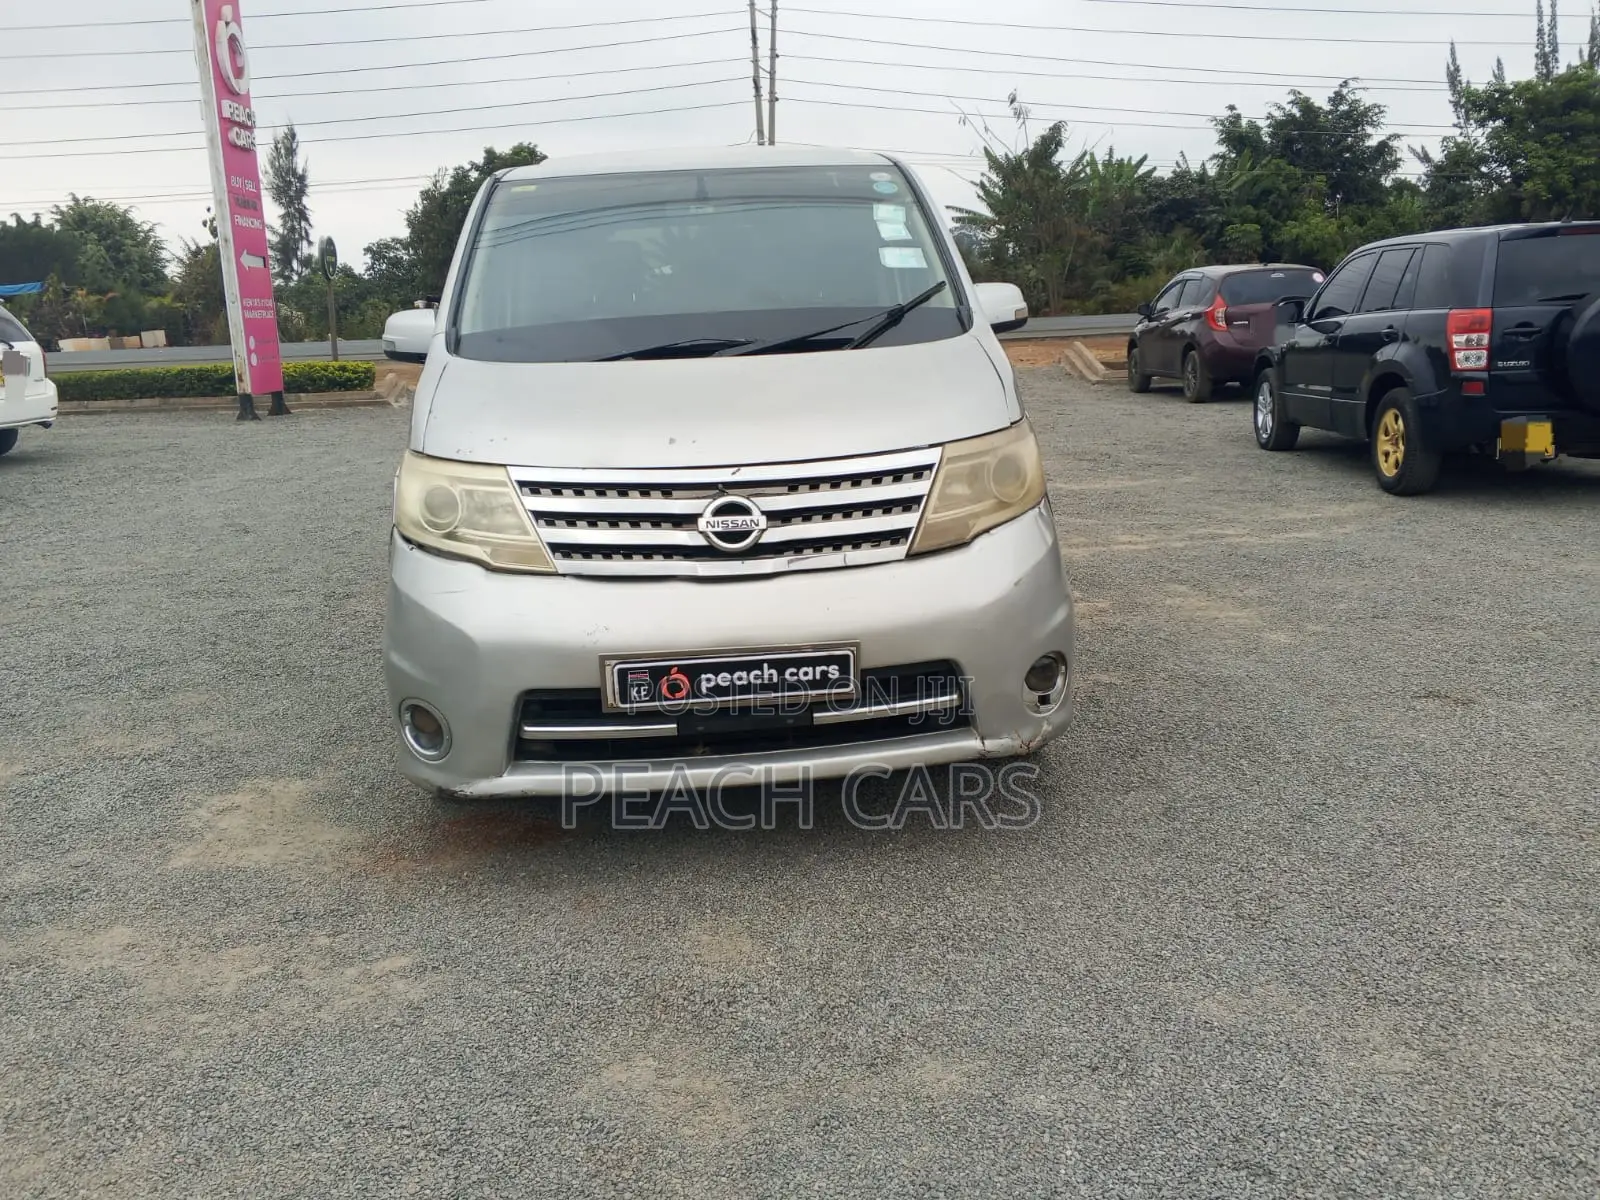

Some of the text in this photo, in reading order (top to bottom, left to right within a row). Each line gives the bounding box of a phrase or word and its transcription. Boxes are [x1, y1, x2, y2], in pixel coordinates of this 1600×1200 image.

[228, 127, 256, 153] CARS
[231, 175, 257, 192] BUY SELL
[234, 214, 263, 229] FINANCING
[705, 519, 760, 529] NISSAN
[700, 663, 840, 695] peach cars
